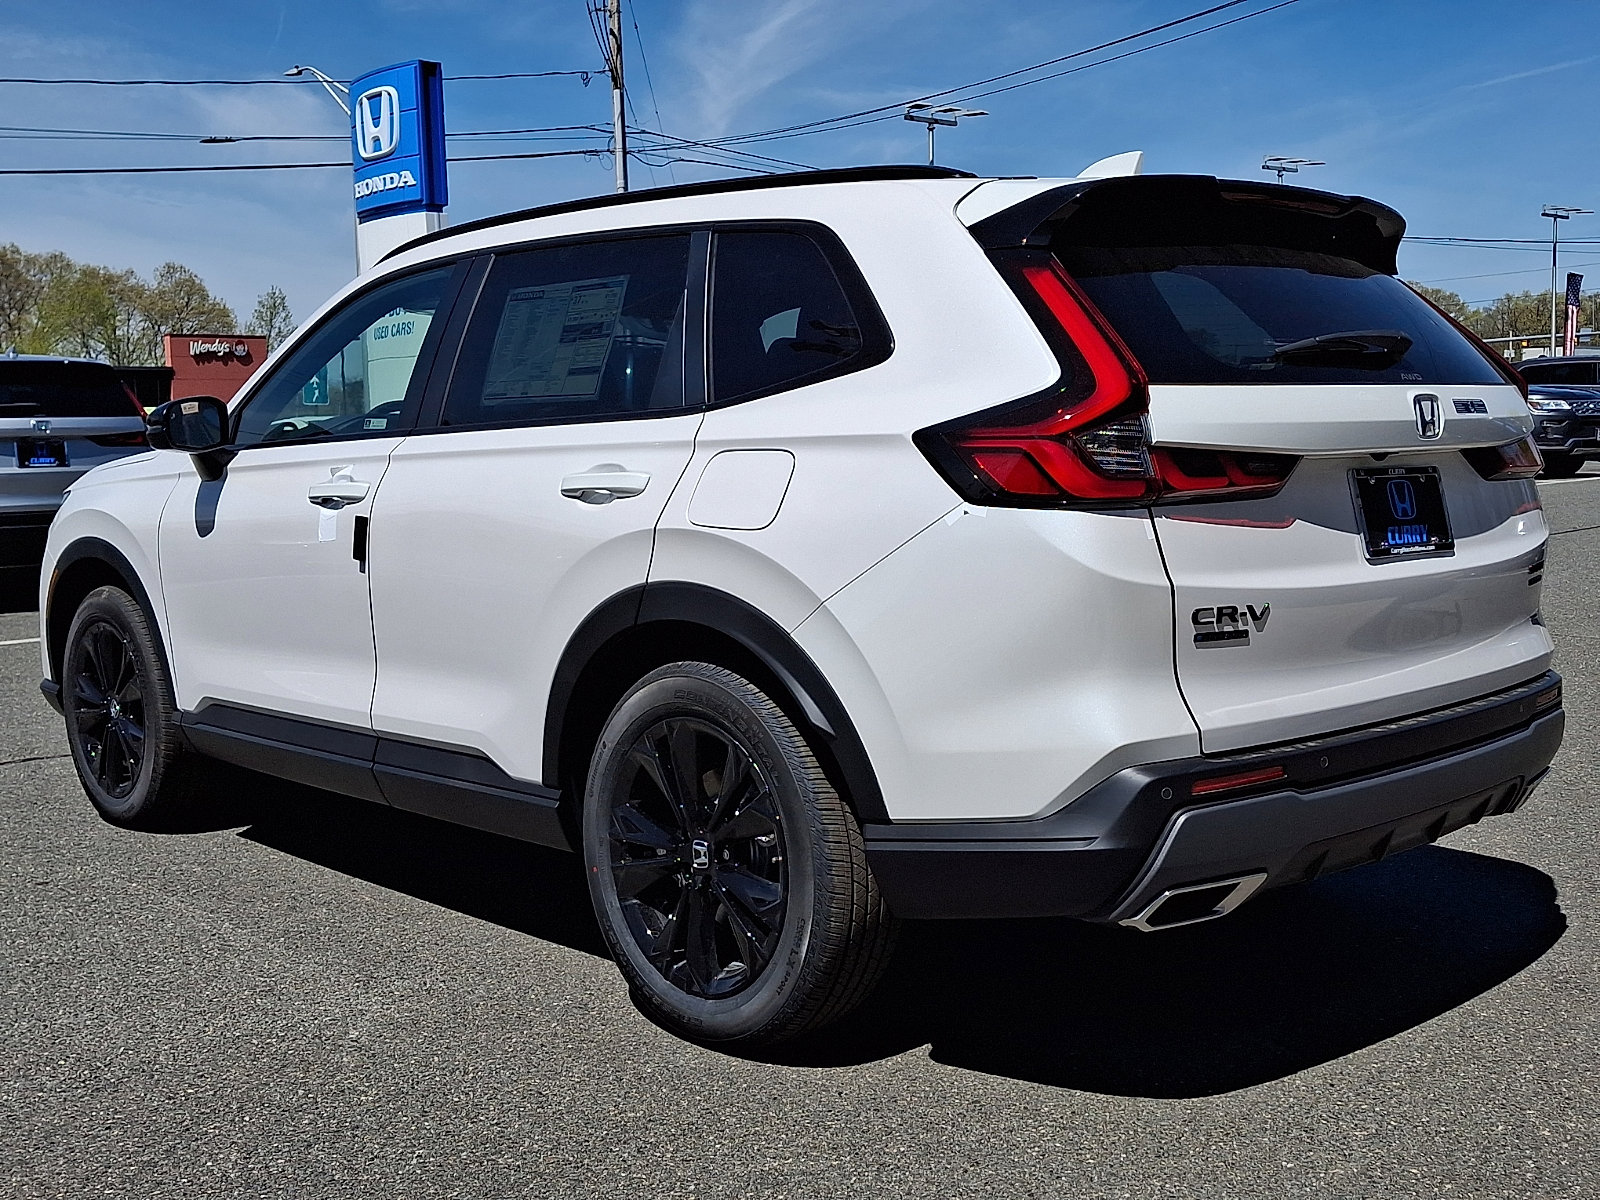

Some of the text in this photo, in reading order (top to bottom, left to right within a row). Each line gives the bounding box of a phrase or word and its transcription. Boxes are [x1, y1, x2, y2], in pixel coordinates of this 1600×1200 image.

[354, 170, 417, 199] HONDA
[373, 320, 415, 341] USED CARS!
[190, 338, 230, 356] Wendy's
[1400, 372, 1422, 381] AWD
[1387, 524, 1428, 545] CURRY
[1191, 602, 1271, 627] CR-V
